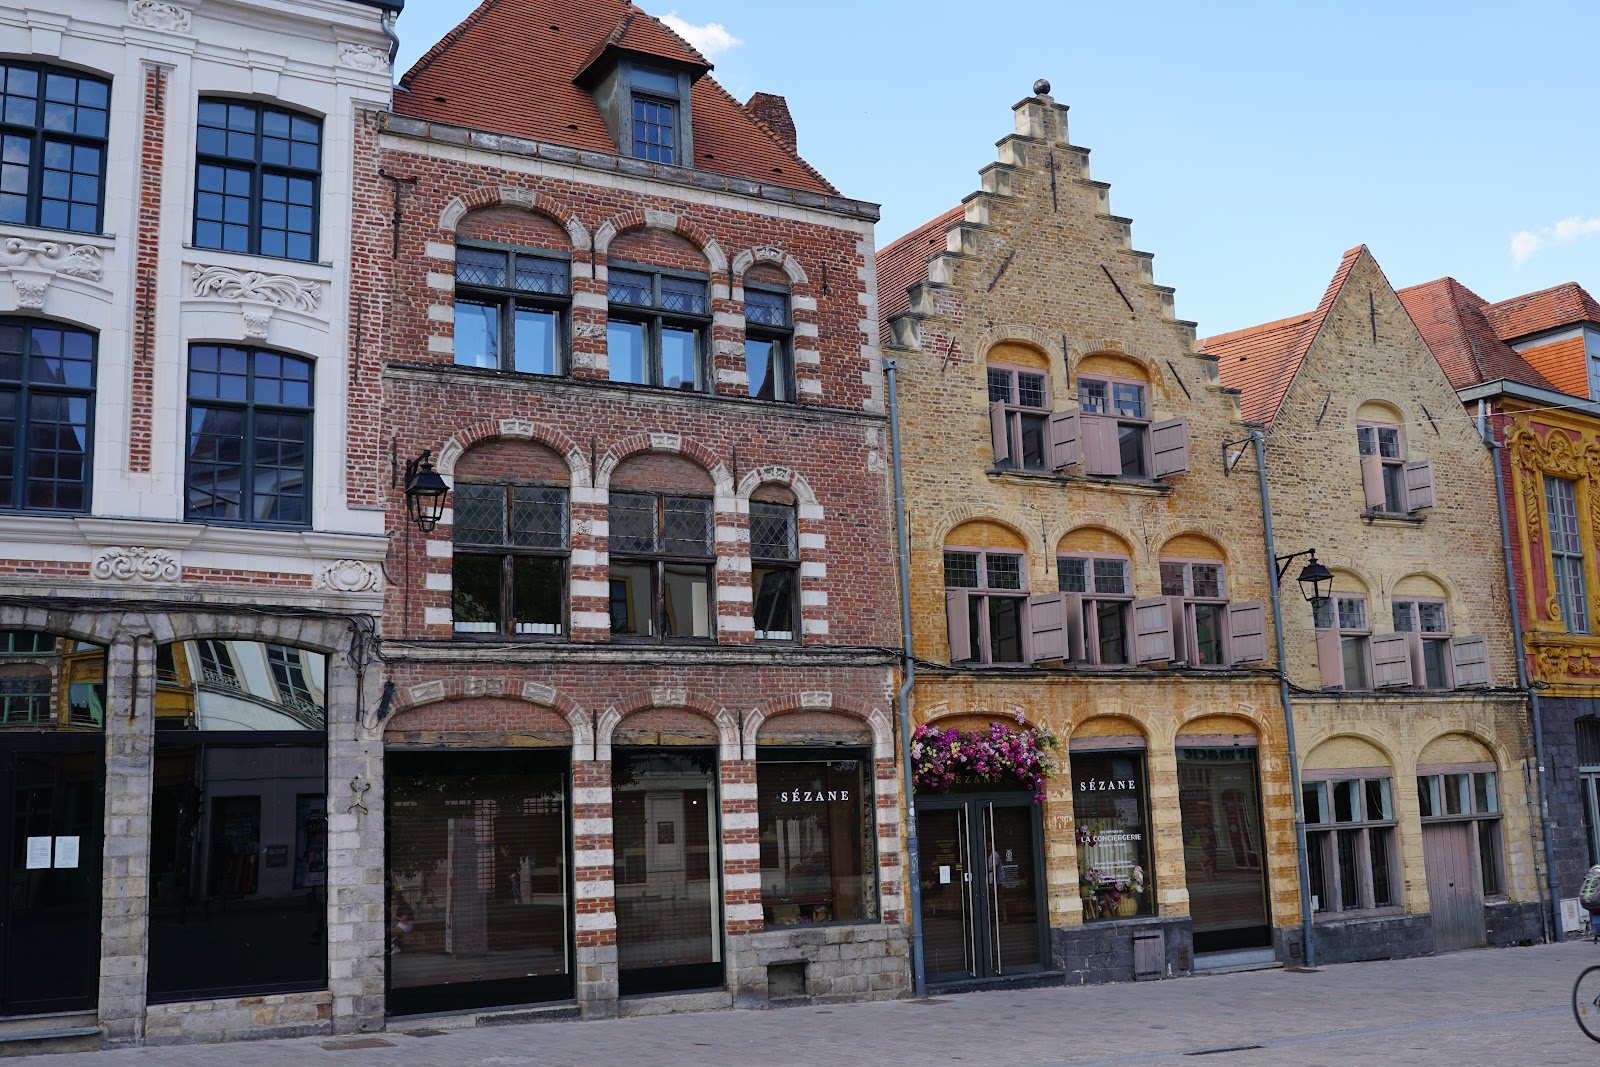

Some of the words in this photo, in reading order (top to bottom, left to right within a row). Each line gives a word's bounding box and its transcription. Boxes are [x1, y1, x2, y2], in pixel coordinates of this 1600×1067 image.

[1080, 778, 1136, 791] SÉZANE
[780, 788, 849, 803] SÉZANE
[1093, 833, 1142, 842] CONCIERGERIE
